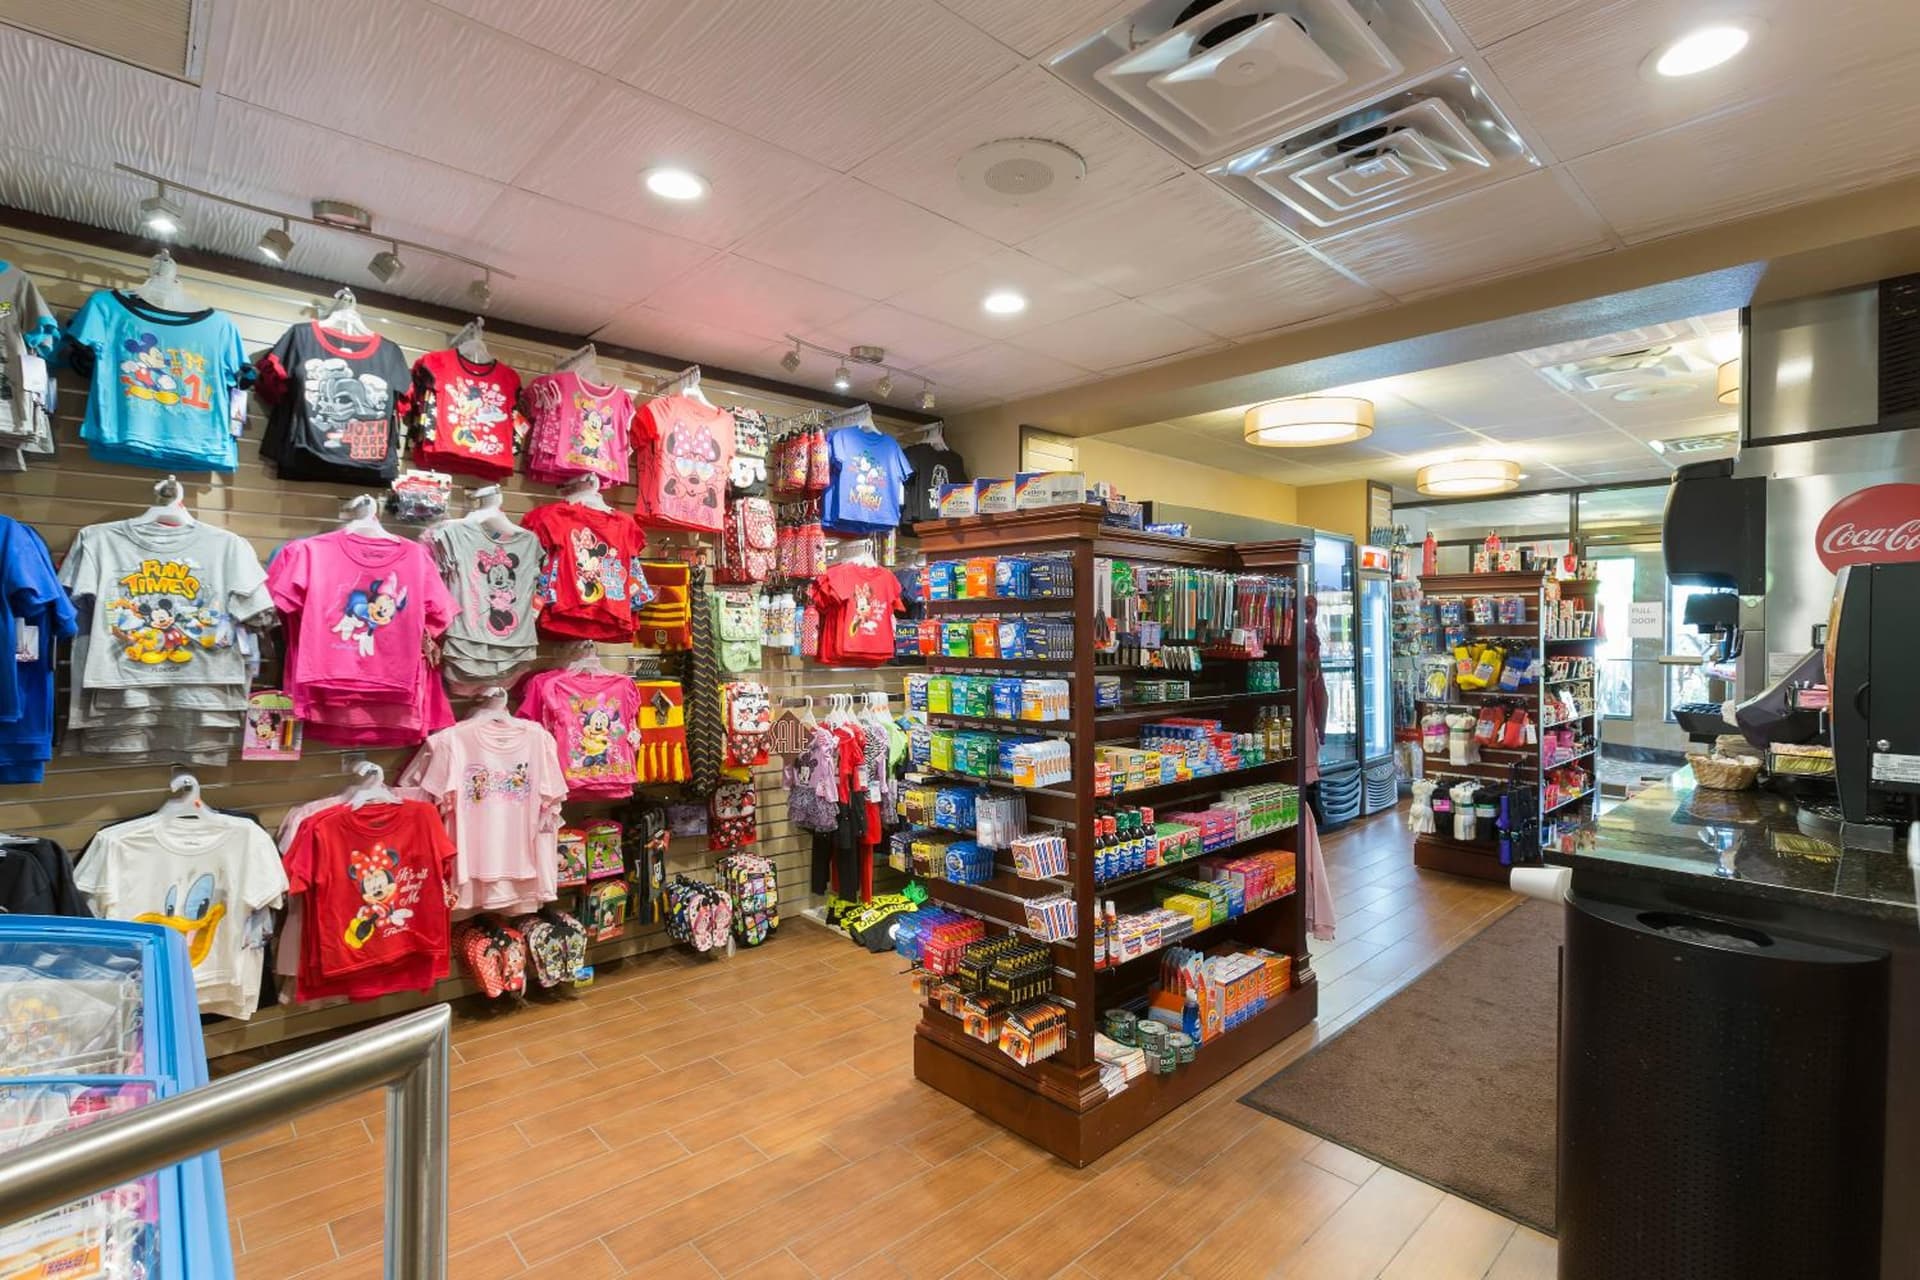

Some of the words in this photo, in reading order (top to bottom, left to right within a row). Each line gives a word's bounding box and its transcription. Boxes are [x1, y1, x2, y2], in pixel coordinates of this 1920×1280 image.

[1823, 519, 1920, 554] Coca-Co
[141, 559, 190, 579] FUN
[119, 573, 200, 600] TIMES
[768, 719, 809, 753] SALE
